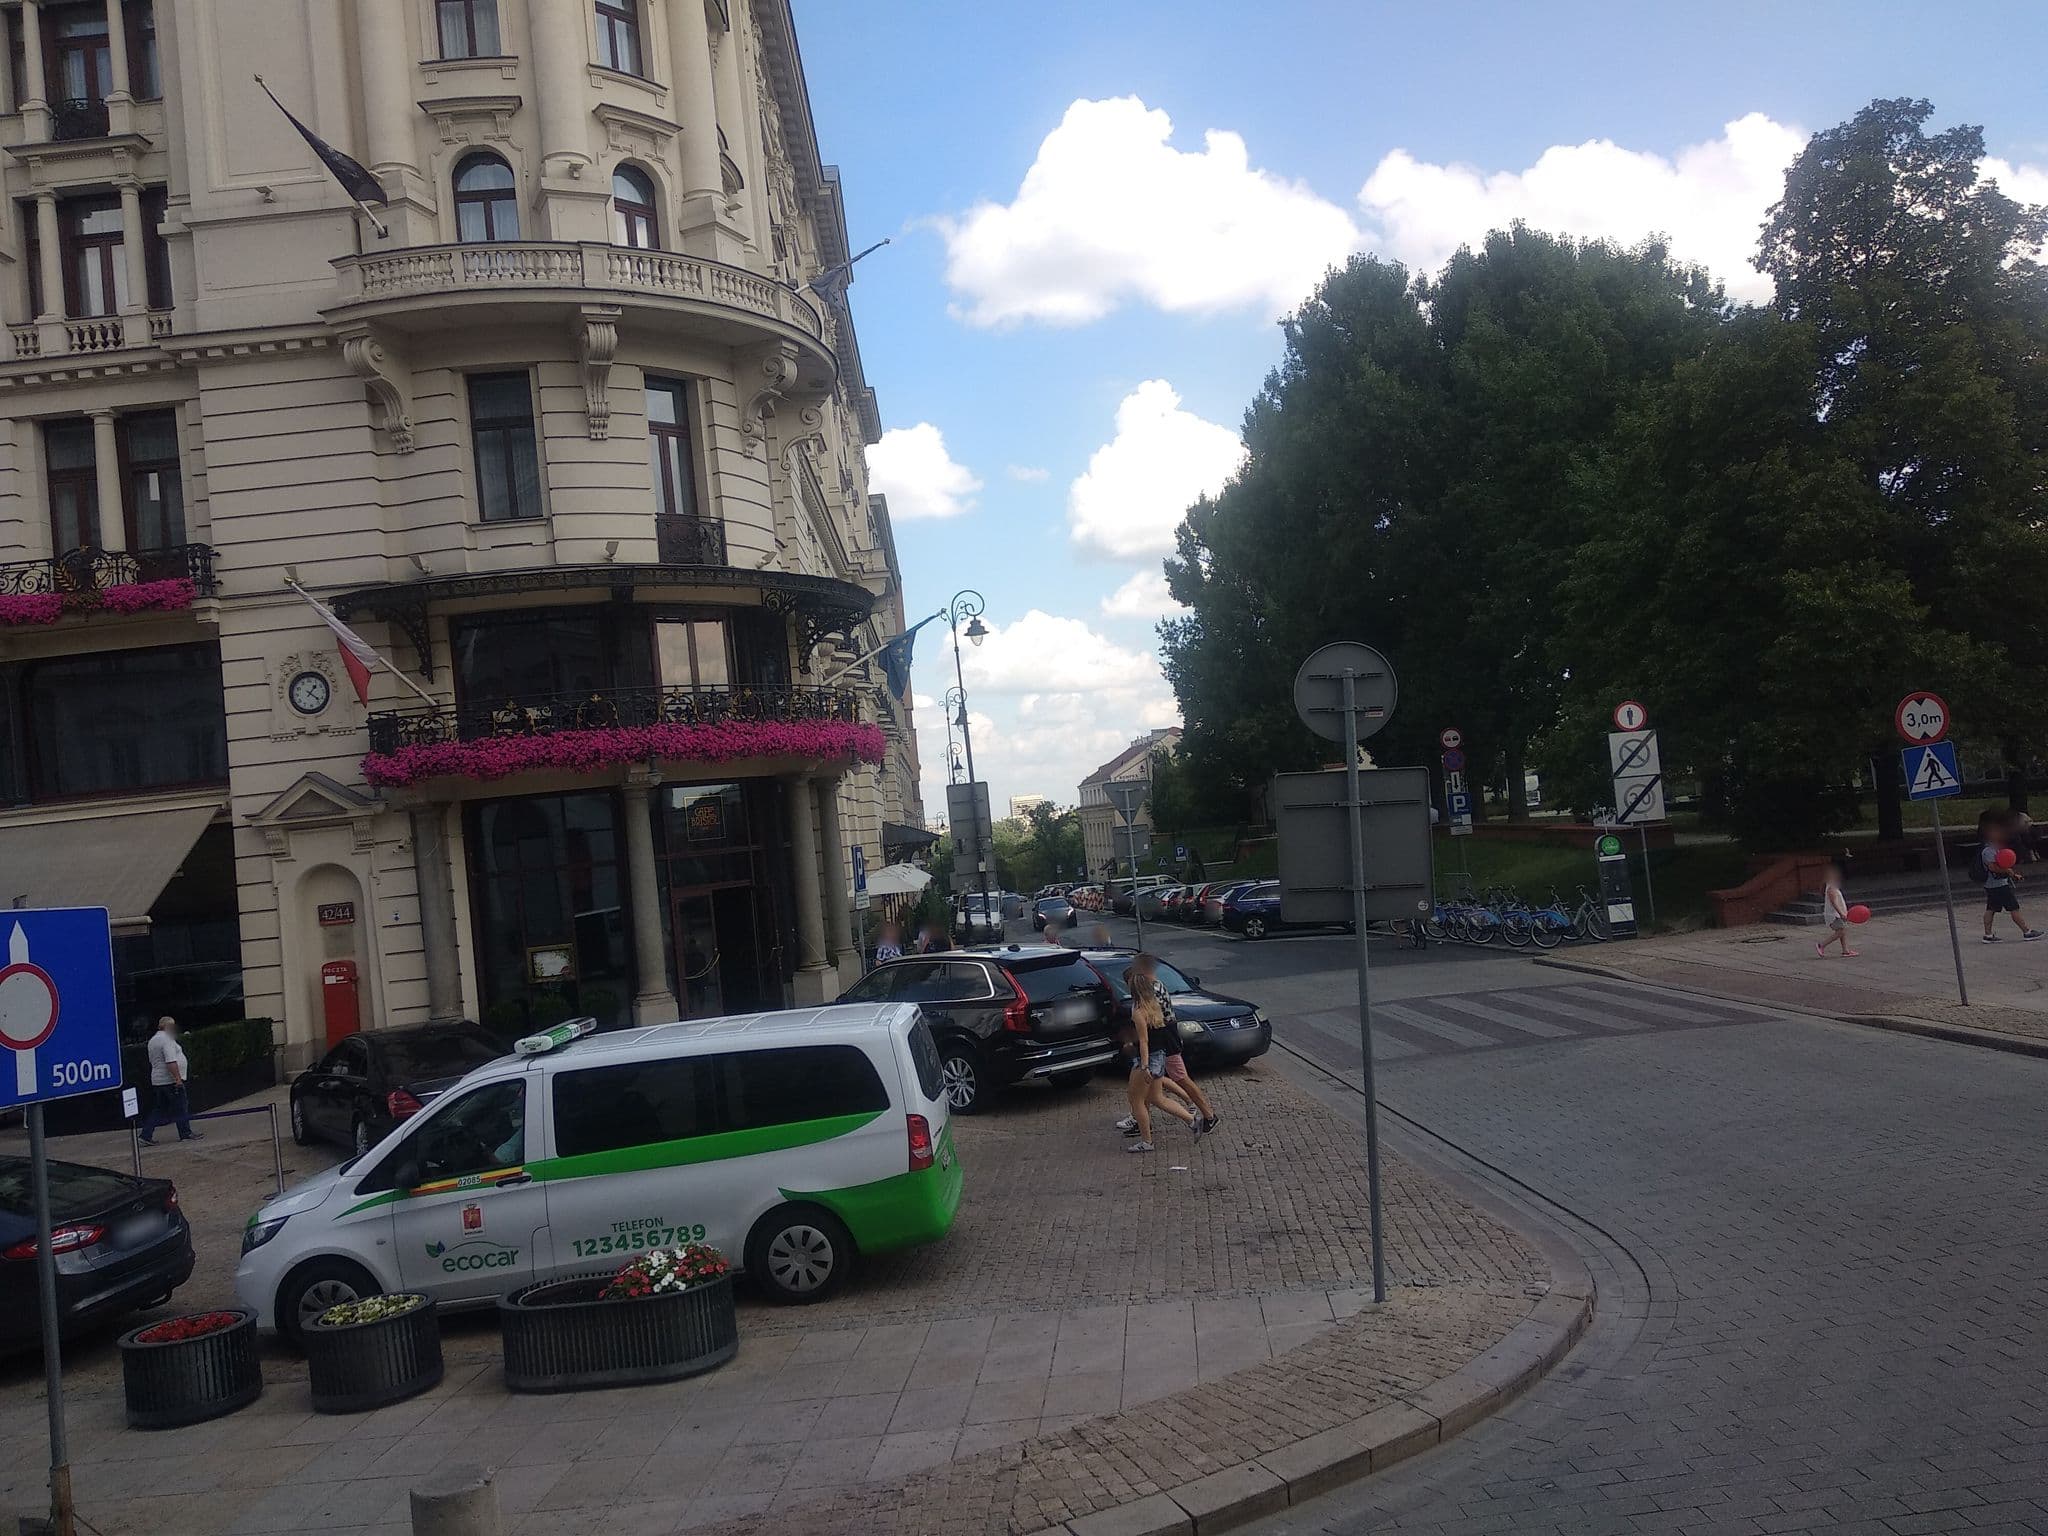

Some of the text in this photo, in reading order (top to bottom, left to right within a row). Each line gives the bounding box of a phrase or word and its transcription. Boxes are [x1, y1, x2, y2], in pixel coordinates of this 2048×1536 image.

[1906, 713, 1941, 728] 3,0m
[322, 905, 351, 920] 42/44
[52, 1059, 112, 1088] 500m
[457, 1175, 482, 1187] 02085
[611, 1217, 664, 1233] TELEFON
[572, 1223, 707, 1257] 123456789
[442, 1248, 520, 1274] ecocar
